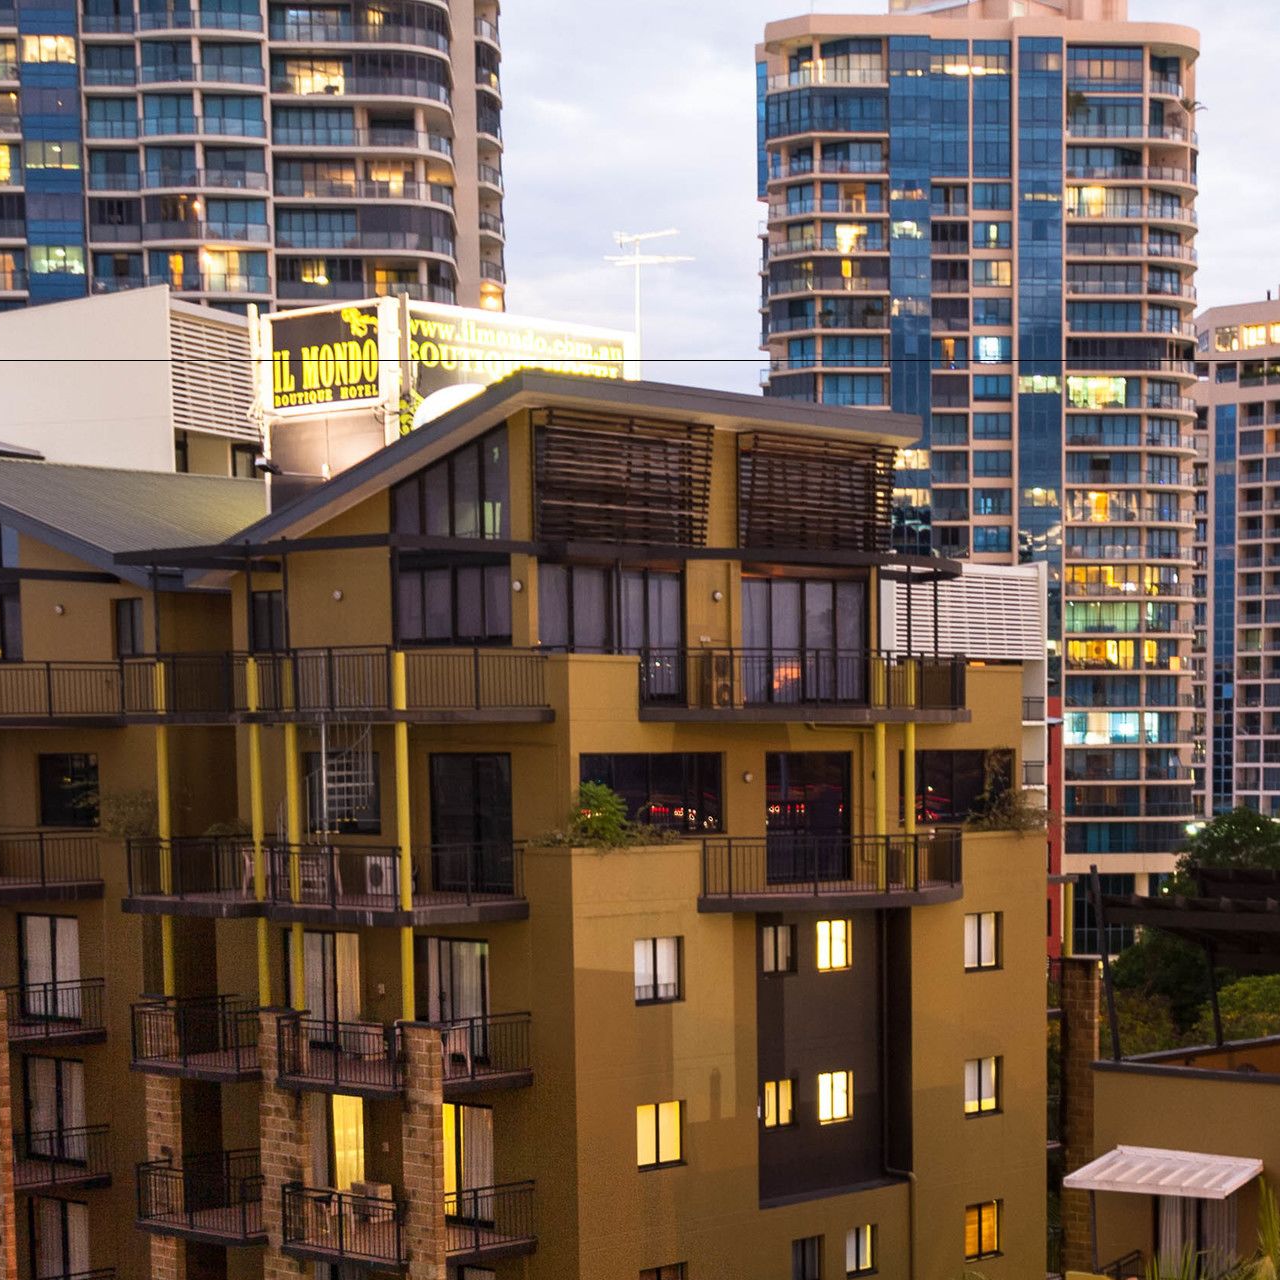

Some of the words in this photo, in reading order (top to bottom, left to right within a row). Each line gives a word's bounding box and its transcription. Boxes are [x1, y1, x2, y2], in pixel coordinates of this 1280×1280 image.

[273, 349, 295, 393] IL
[301, 338, 378, 390] MONDO
[274, 388, 333, 407] BOUTIQUE
[340, 383, 379, 400] HOTEL
